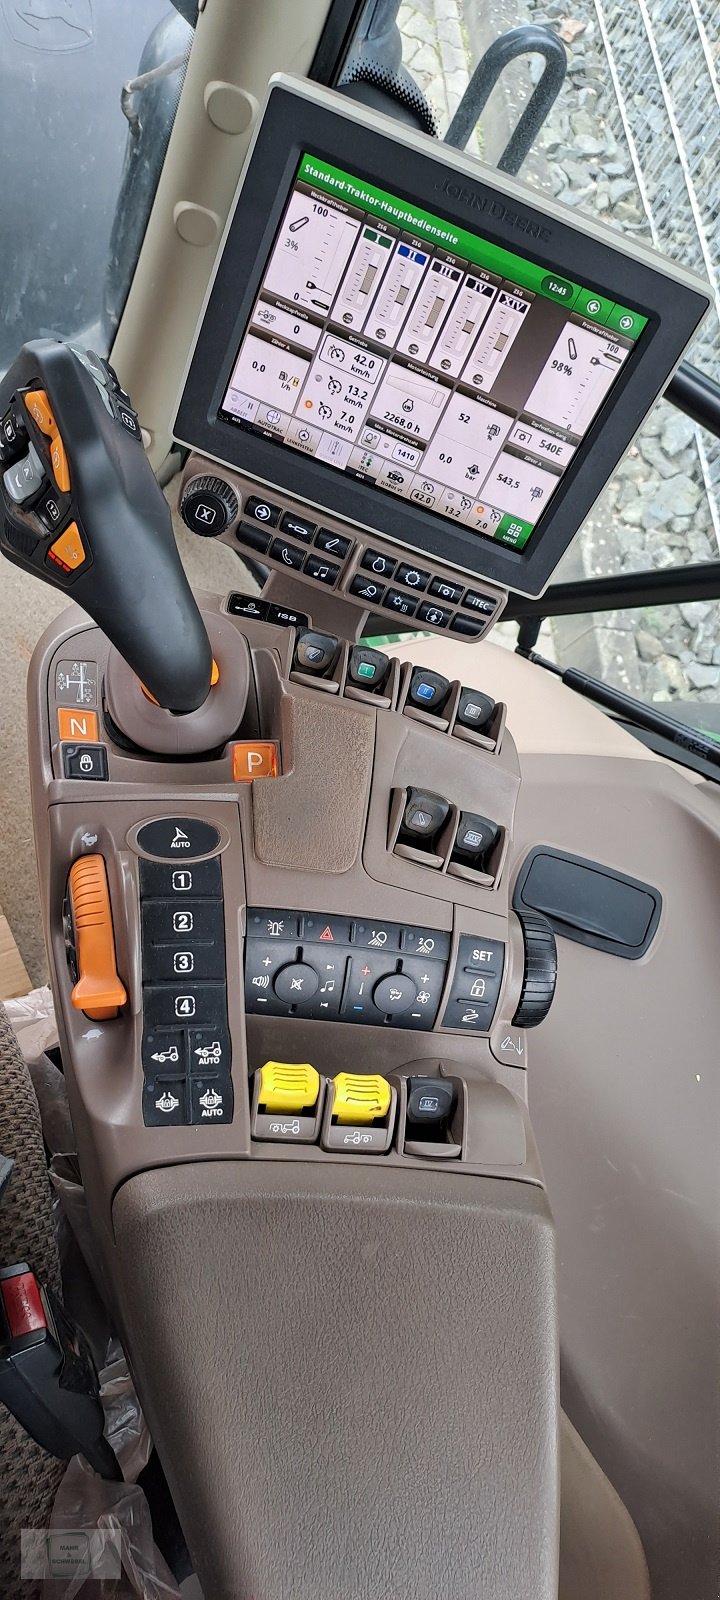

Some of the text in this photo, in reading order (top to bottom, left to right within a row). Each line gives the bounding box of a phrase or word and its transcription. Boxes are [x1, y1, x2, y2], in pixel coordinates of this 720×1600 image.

[303, 163, 459, 246] Standard-Traktor-Hauptbedienseite
[312, 203, 329, 218] 100
[434, 178, 552, 243] JOHN DEERE
[284, 238, 299, 251] 3%
[407, 250, 417, 261] II
[438, 264, 452, 279] III
[474, 281, 487, 293] IV
[548, 281, 567, 297] 12:45
[293, 292, 300, 301] 0
[502, 295, 524, 310] XIV
[293, 325, 300, 335] 0
[606, 343, 620, 354] 100
[251, 360, 266, 373] 0,0
[353, 353, 375, 369] 42.0
[550, 359, 573, 376] 98%
[350, 365, 371, 379] km/h
[348, 384, 368, 400] 13.2
[344, 395, 364, 409] km/h
[340, 411, 355, 424] 7.0
[384, 411, 420, 433] 2268,0 h
[458, 413, 470, 424] 52
[258, 419, 283, 434] AUTOTRAC
[334, 419, 353, 434] km/h
[397, 449, 415, 461] 1410
[539, 440, 563, 456] 540E
[438, 453, 453, 464] 0,0
[386, 471, 405, 484] ISO
[464, 473, 476, 481] bar
[496, 473, 520, 489] 543,5
[414, 492, 431, 504] 42.0
[49, 502, 59, 519] 12
[444, 505, 461, 517] 13.2
[475, 520, 488, 529] 7.0
[471, 597, 490, 610] iTEC
[277, 612, 297, 622] ISB
[70, 718, 87, 736] N
[247, 751, 263, 773] P
[170, 840, 191, 849] AUTO
[178, 874, 186, 888] 1
[178, 916, 188, 928] 2
[179, 955, 189, 969] 3
[472, 949, 493, 963] SET
[180, 999, 190, 1013] 4
[198, 1056, 220, 1065] AUTO
[201, 1107, 223, 1117] AUTO
